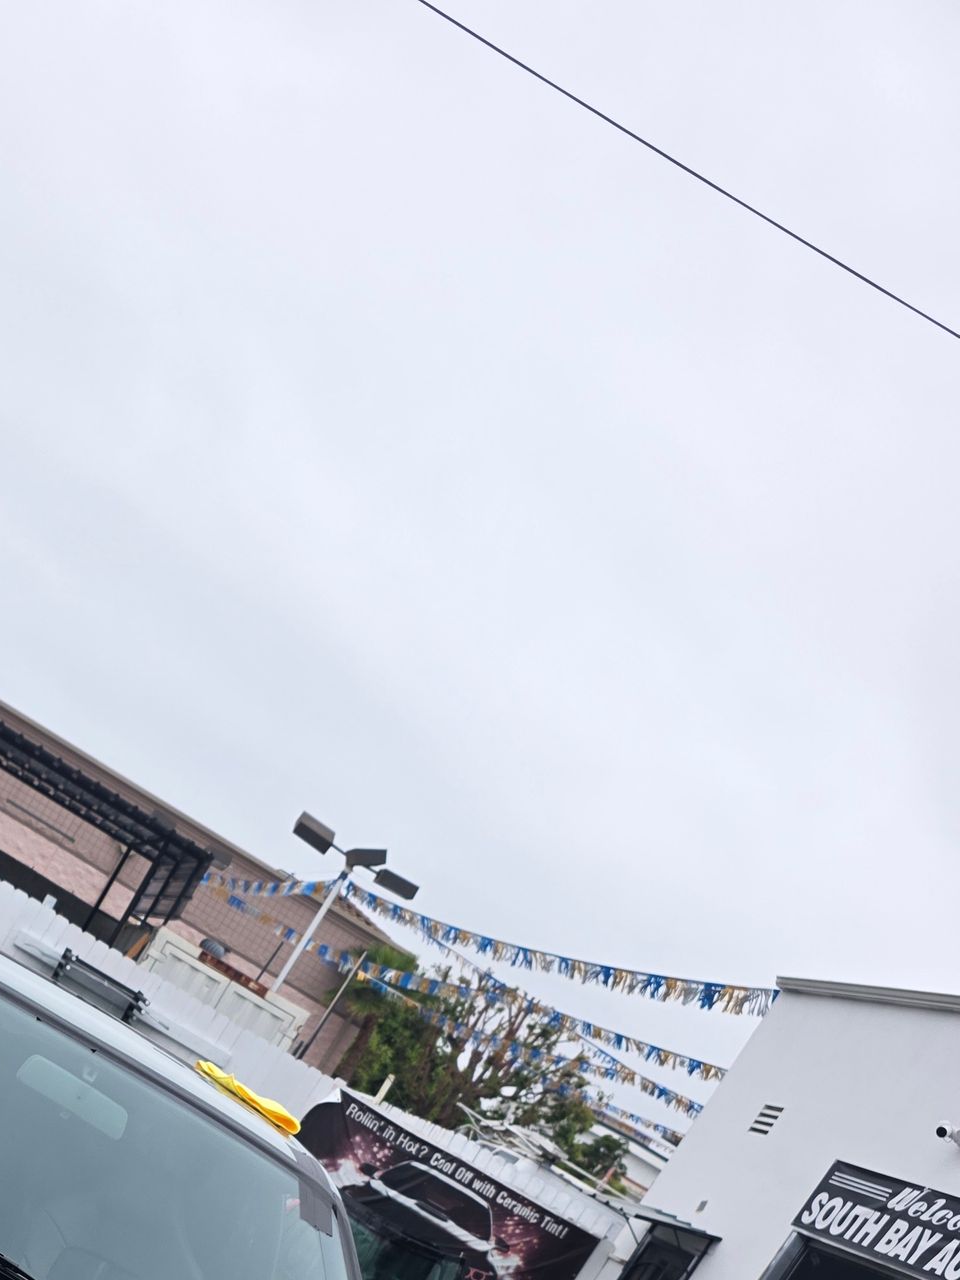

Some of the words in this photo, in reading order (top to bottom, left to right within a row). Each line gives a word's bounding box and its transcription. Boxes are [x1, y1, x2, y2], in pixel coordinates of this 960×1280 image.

[382, 1125, 395, 1141] in
[430, 1152, 456, 1175] Cool
[454, 1167, 474, 1184] Off
[472, 1178, 496, 1198] with
[496, 1191, 540, 1223] Ceramic
[541, 1215, 568, 1239] Tint!
[801, 1192, 890, 1247] SOUTH
[873, 1218, 943, 1265] BAY
